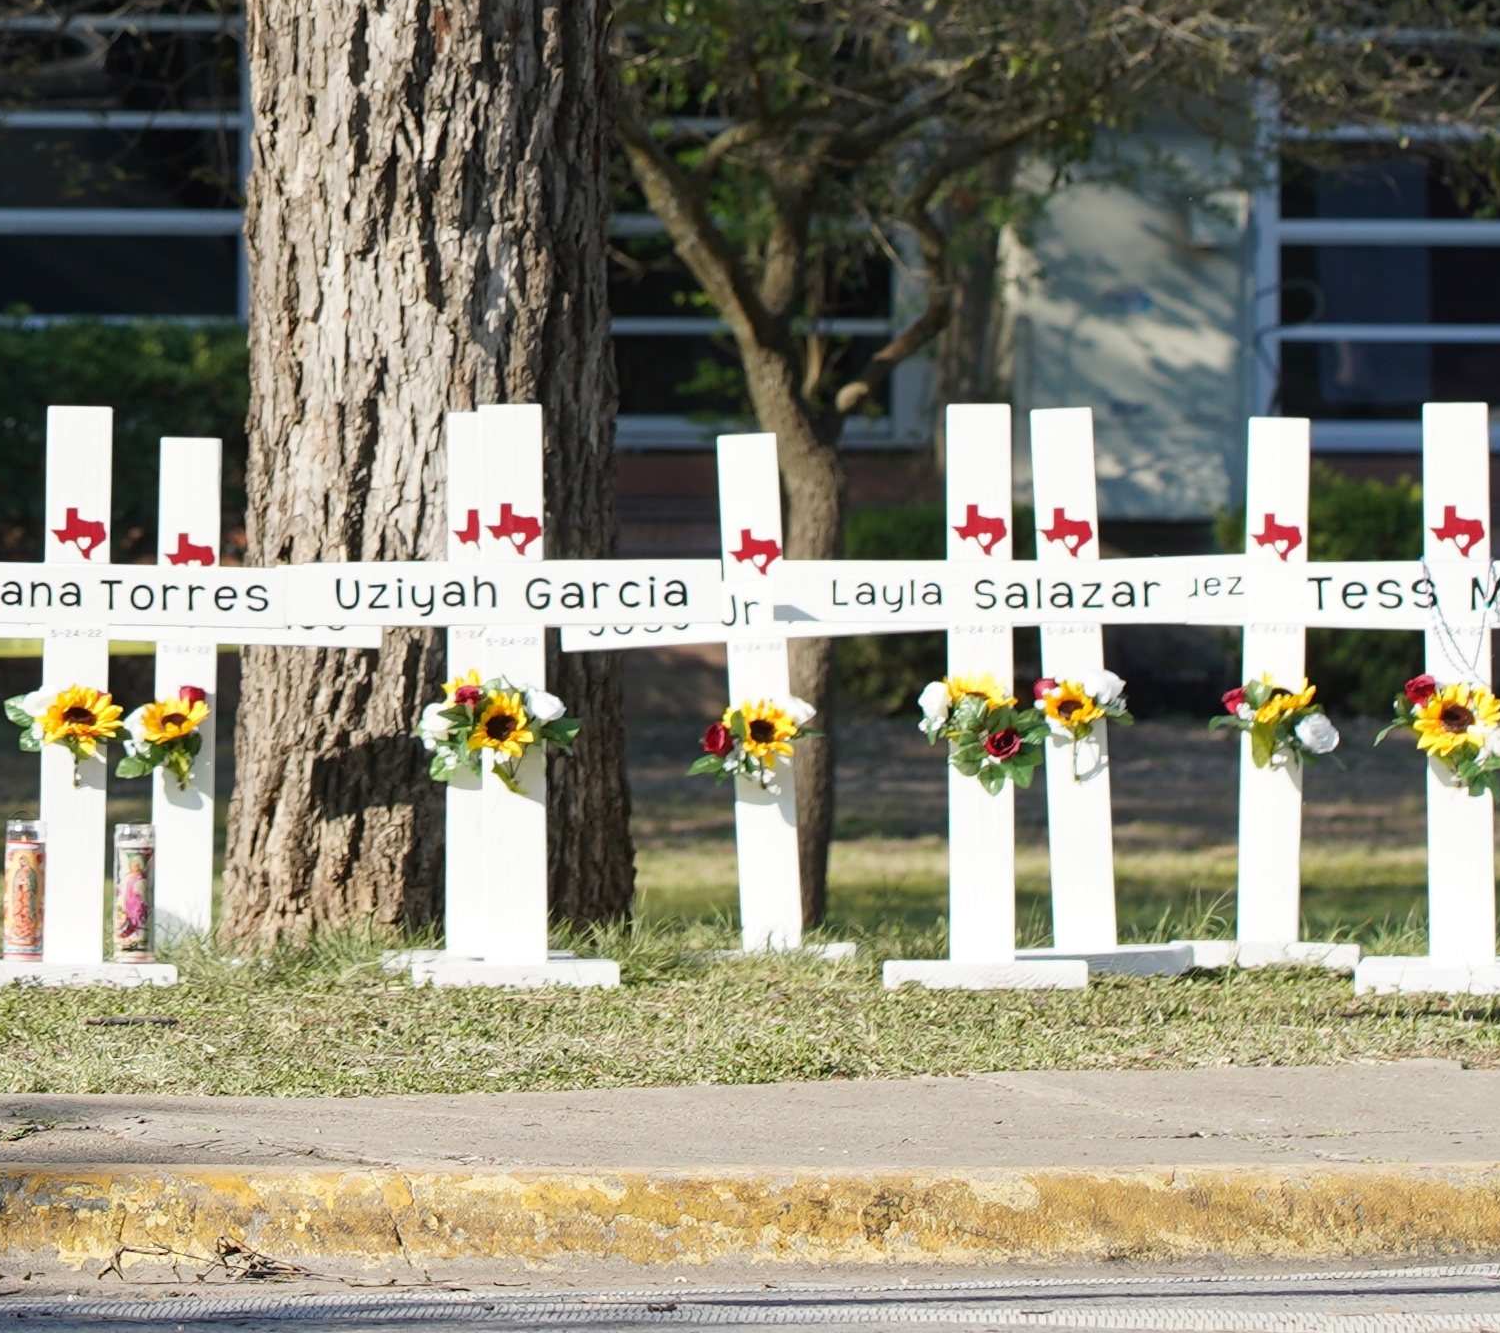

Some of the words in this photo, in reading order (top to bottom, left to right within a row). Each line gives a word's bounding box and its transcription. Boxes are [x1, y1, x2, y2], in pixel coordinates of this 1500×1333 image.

[101, 580, 268, 611] Torres
[336, 576, 496, 616] Uziyah
[526, 577, 687, 610] Garcia
[833, 580, 941, 612] Layla
[975, 579, 1160, 609] Salazar
[1308, 577, 1438, 610] Tess
[722, 595, 758, 626] Jr
[50, 629, 103, 639] 5-24-22
[486, 637, 539, 646] 5-24-22
[954, 625, 1007, 635] 5-24-22
